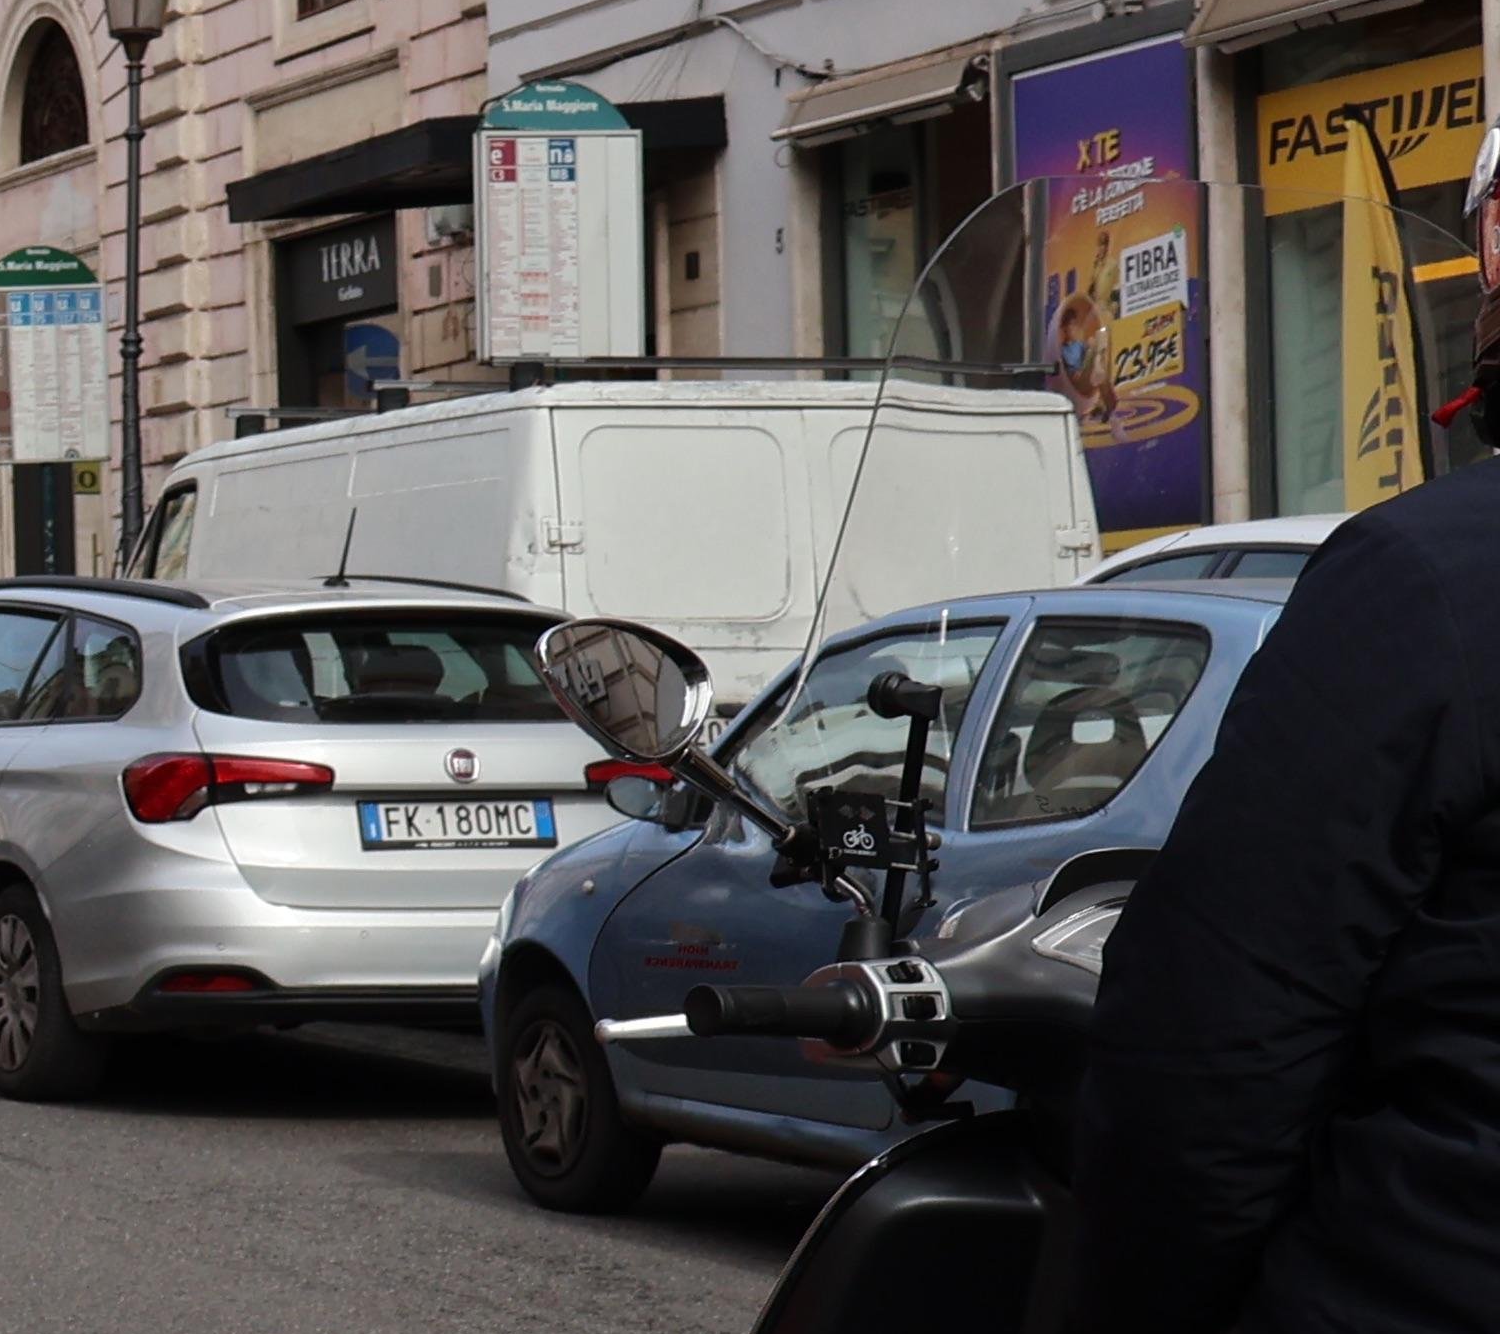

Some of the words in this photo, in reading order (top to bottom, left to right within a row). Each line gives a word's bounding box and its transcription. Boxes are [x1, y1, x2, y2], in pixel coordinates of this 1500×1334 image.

[546, 99, 598, 114] Maggiore
[35, 260, 79, 273] Maggiore
[319, 235, 381, 283] TERRA
[1125, 240, 1178, 282] FIBRA
